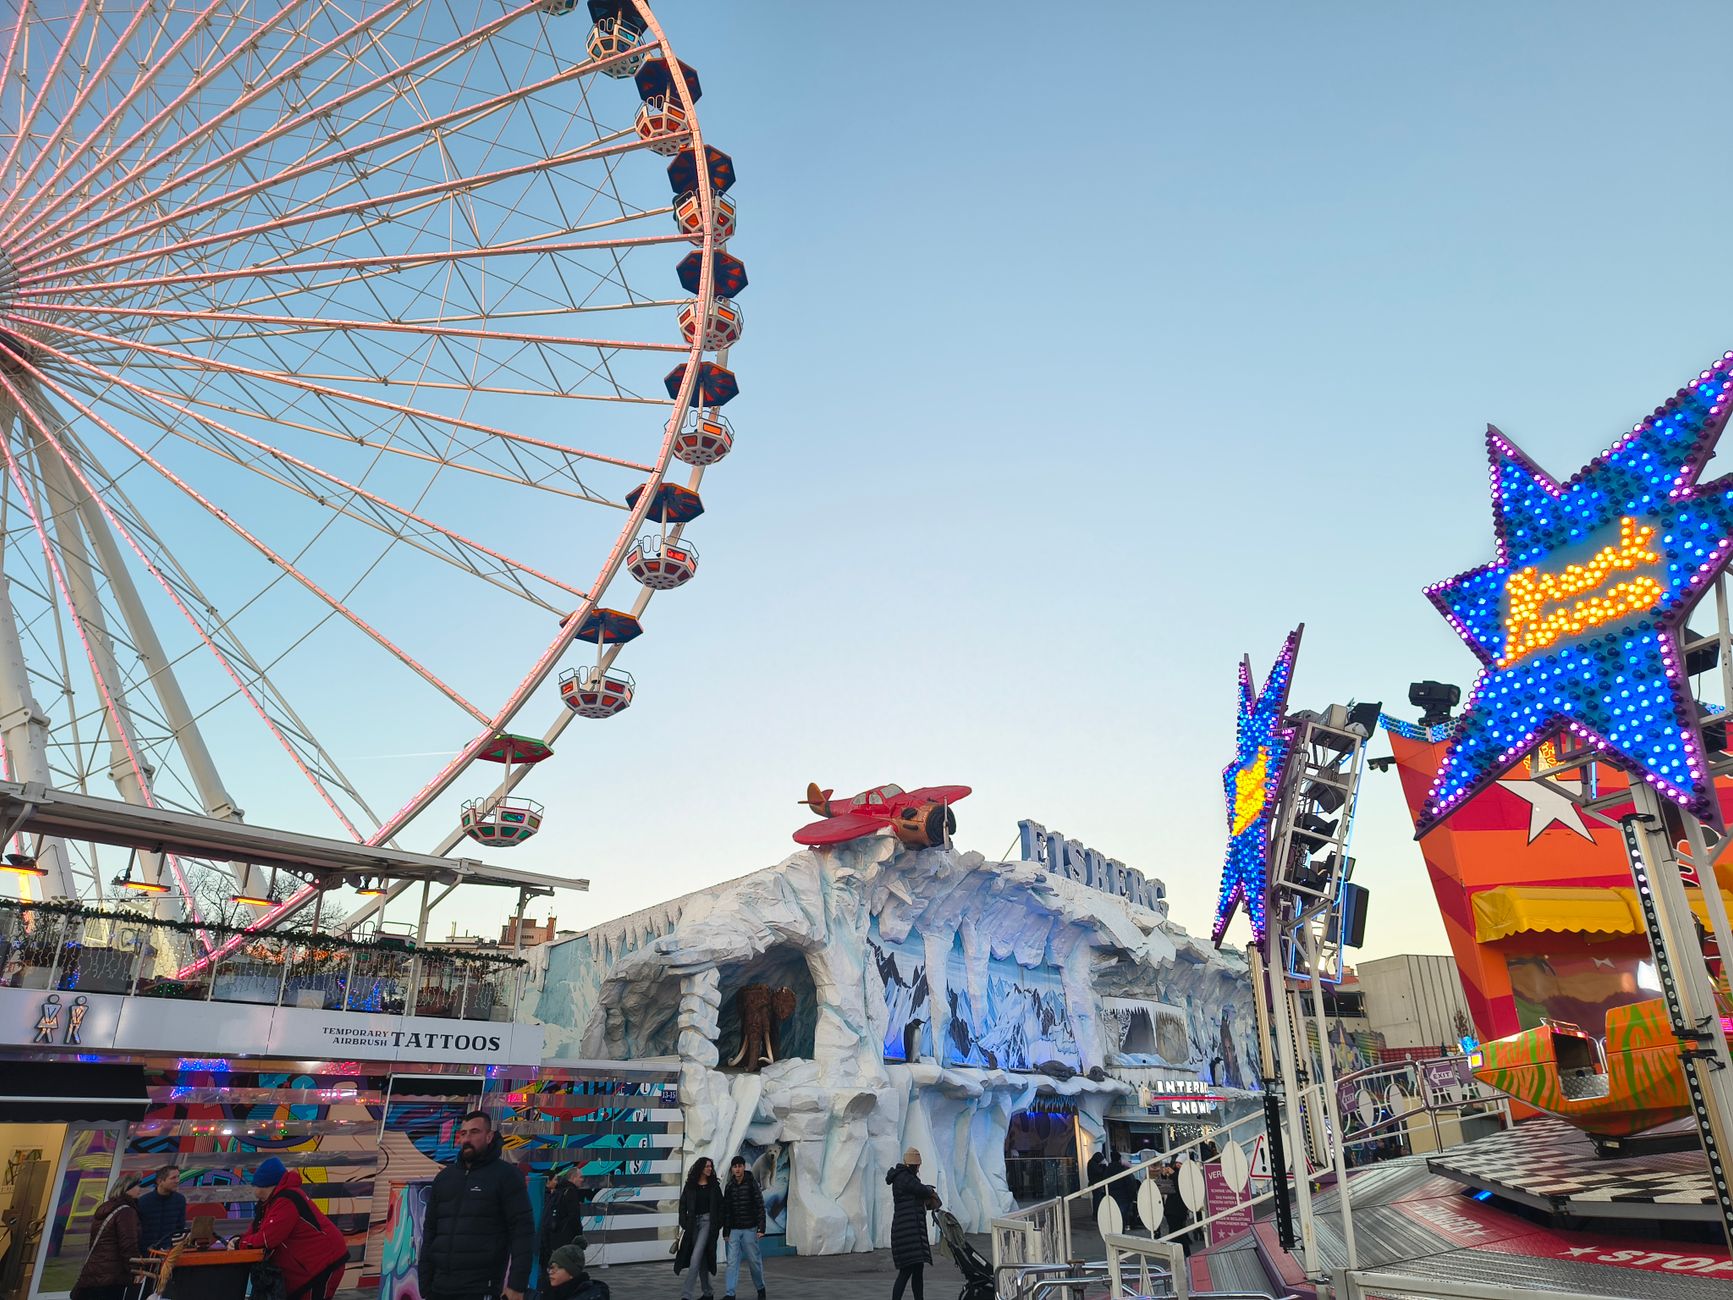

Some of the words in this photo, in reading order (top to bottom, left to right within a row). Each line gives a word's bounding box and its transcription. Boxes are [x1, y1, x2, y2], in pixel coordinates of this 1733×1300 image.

[1018, 819, 1170, 921] EISBERG
[322, 1026, 390, 1038] TEMPORARY
[332, 1036, 388, 1047] AIRBRUSH
[391, 1031, 501, 1052] TATTOOS
[1432, 1072, 1450, 1080] EXIT
